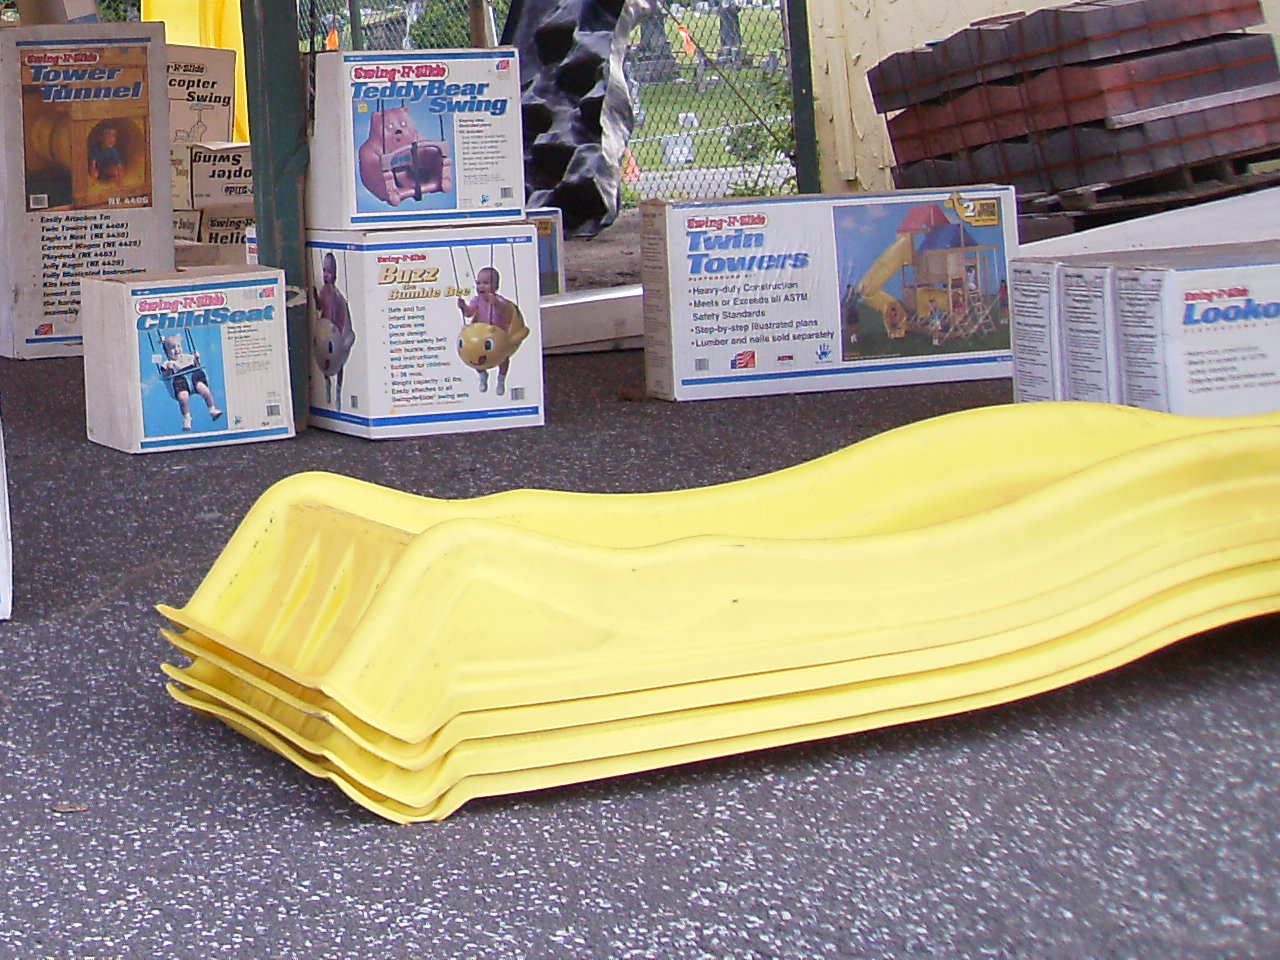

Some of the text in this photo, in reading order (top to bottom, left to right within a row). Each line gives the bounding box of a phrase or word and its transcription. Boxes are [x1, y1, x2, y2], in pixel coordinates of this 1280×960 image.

[30, 65, 123, 83] Tower
[41, 81, 143, 102] Tunnel
[186, 91, 232, 107] Swing
[351, 80, 490, 103] TeddyBear
[428, 96, 508, 117] Swing
[192, 151, 242, 166] Swing
[686, 229, 765, 251] Twin
[686, 252, 810, 274] Towers
[378, 264, 440, 285] Buzz
[388, 288, 441, 300] Bumble
[693, 299, 719, 308] Meets
[783, 293, 808, 303] ASTM
[136, 305, 276, 331] ChildSeat
[693, 309, 766, 321] Safety Standards
[695, 338, 729, 347] Lumber
[731, 335, 747, 345] and
[749, 334, 770, 344] nails
[772, 332, 790, 342] sold
